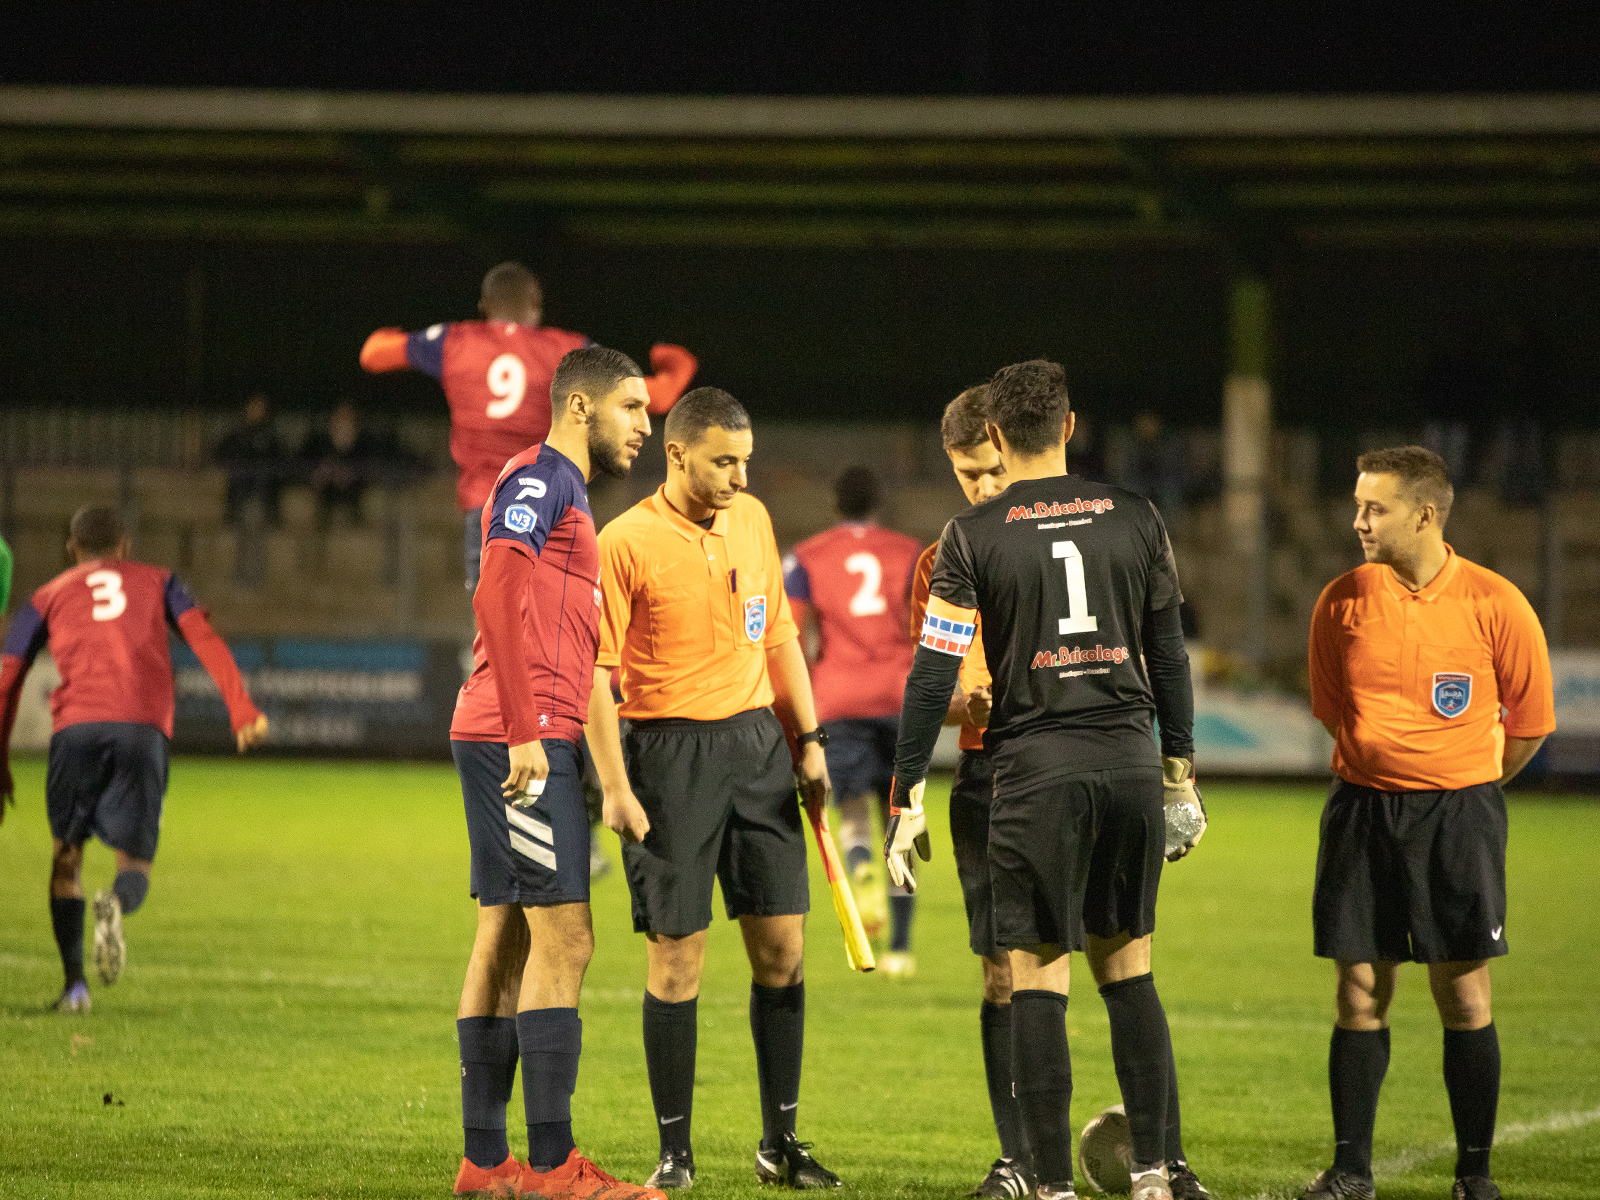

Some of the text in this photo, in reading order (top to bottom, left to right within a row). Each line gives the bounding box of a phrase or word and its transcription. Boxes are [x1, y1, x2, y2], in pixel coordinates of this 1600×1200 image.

[486, 353, 527, 419] 9
[511, 510, 532, 528] N3
[86, 570, 127, 621] 3
[844, 553, 888, 616] 2
[1052, 540, 1098, 635] 1
